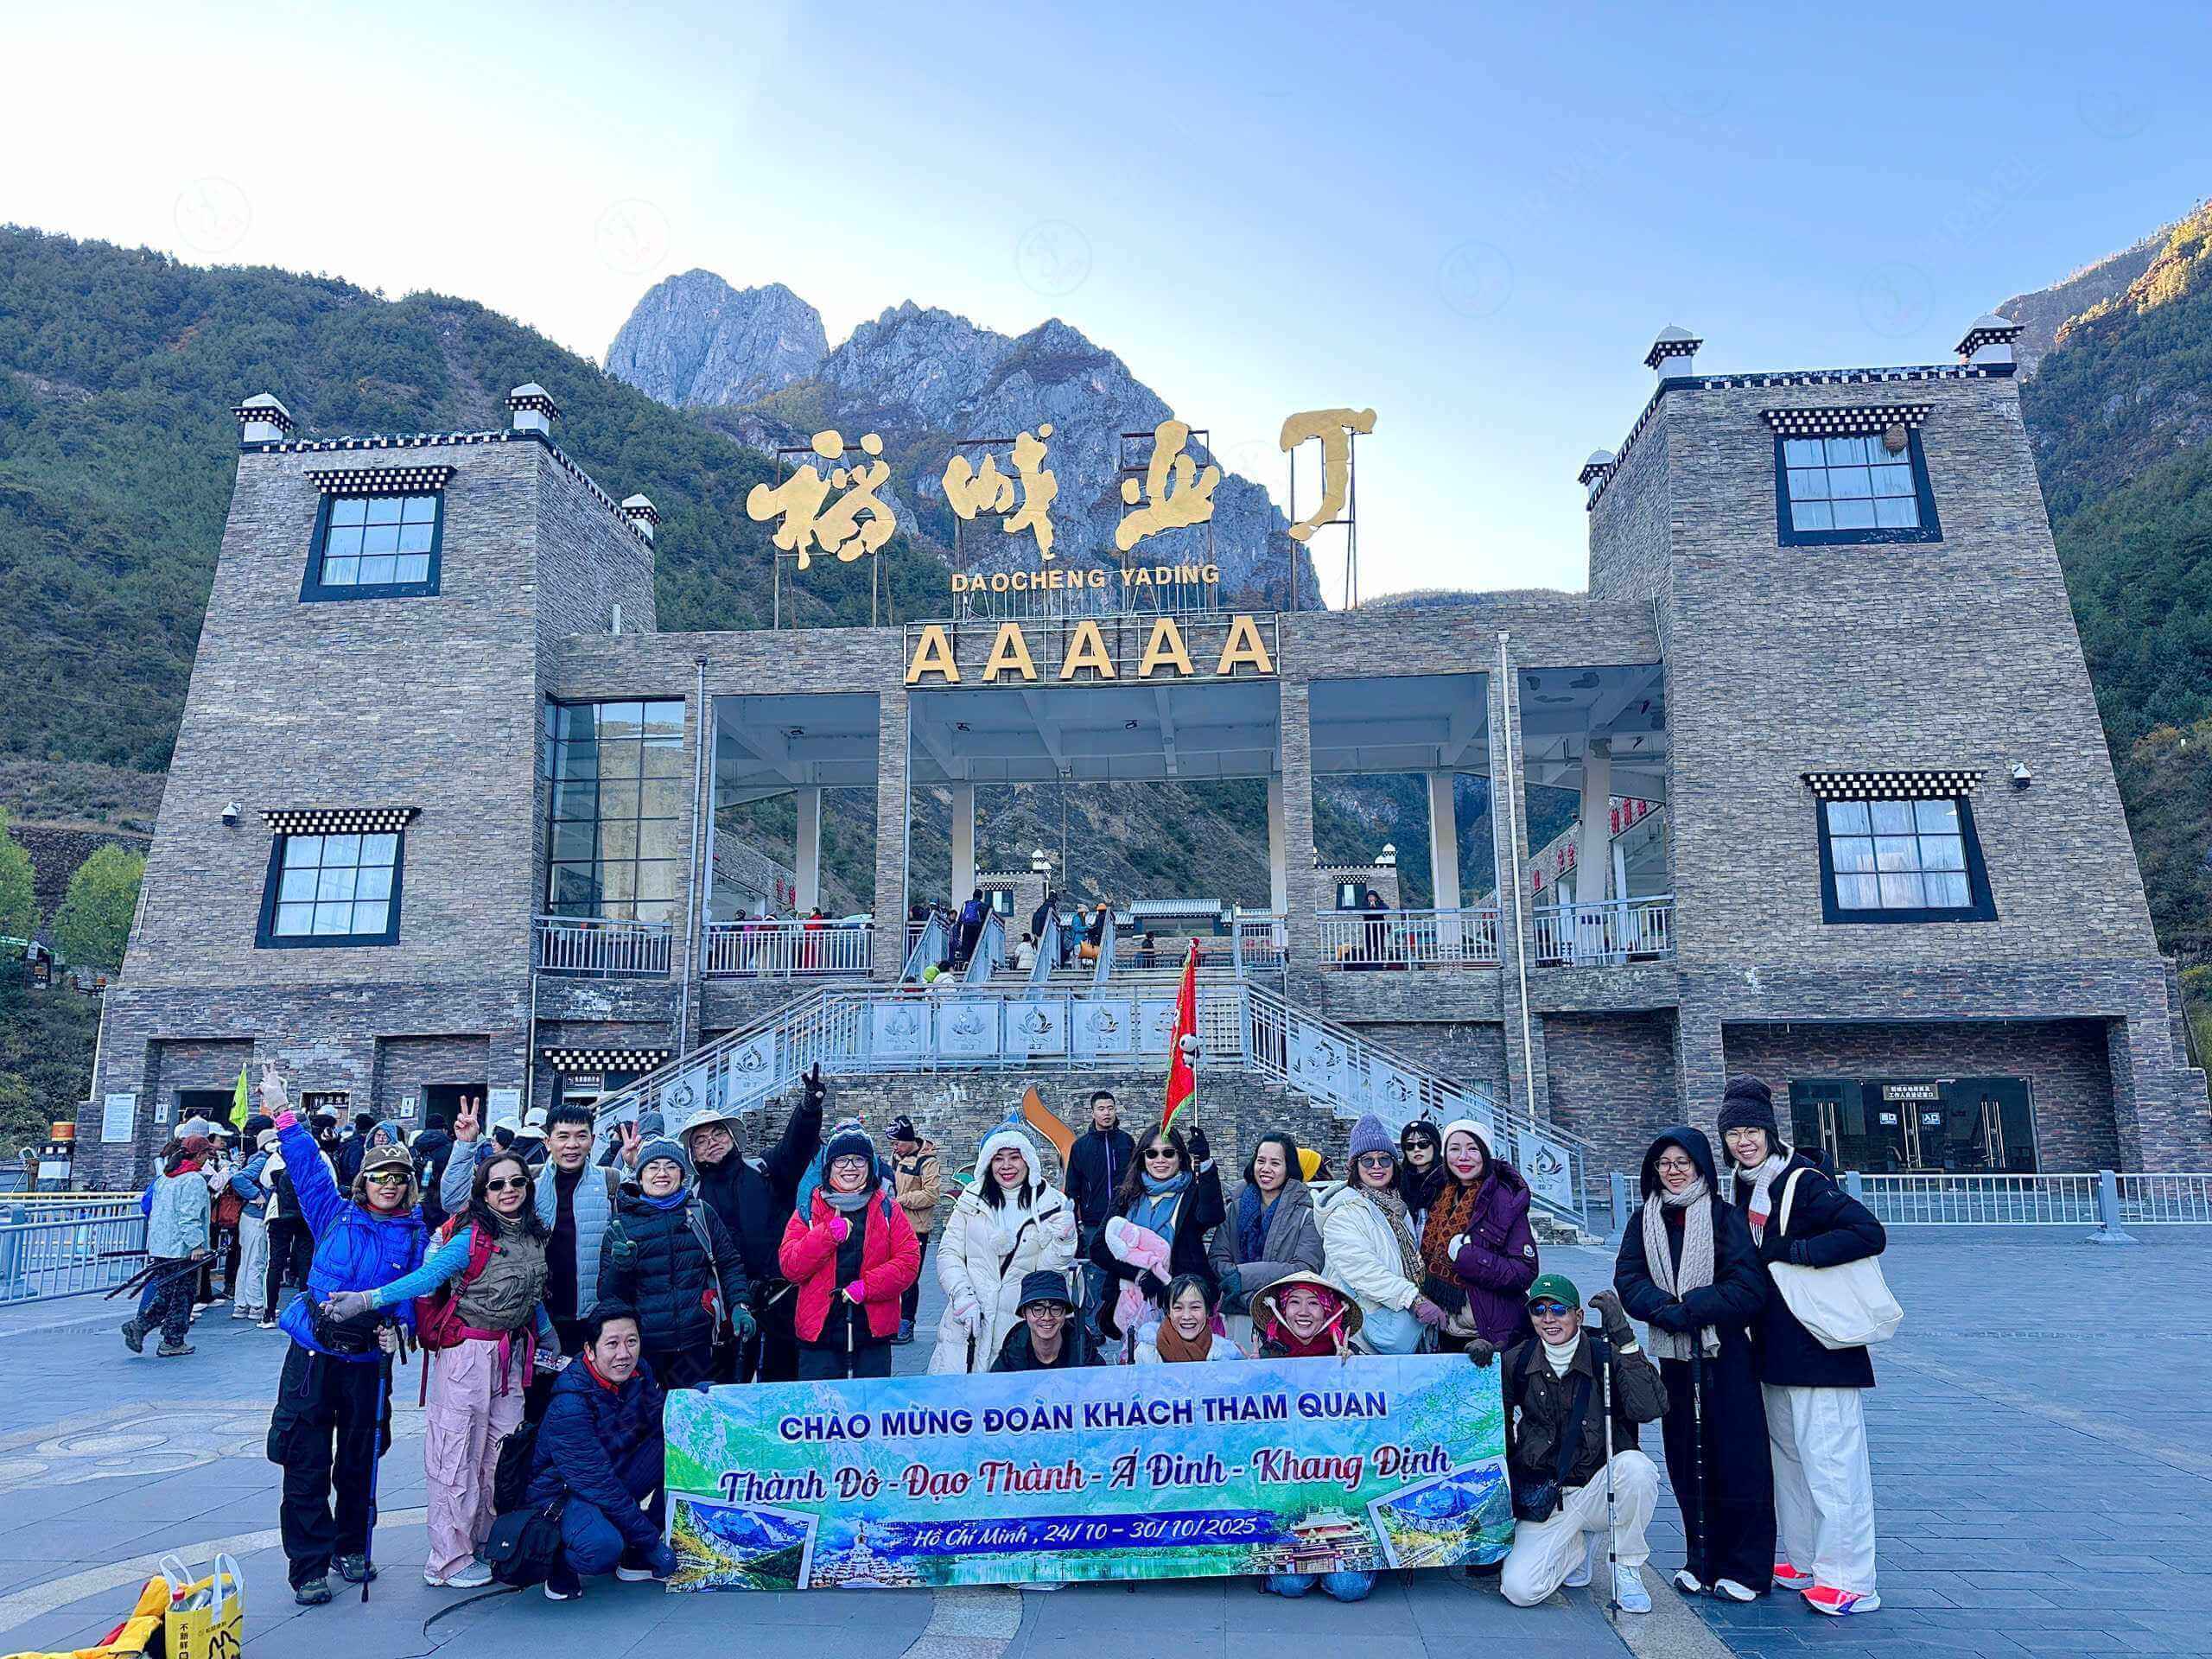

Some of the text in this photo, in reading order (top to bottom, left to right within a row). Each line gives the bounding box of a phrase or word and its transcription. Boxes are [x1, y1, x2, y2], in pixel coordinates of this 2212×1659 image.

[950, 564, 1220, 593] DAOCHENG YADING
[780, 1391, 1388, 1441] CHÀO MỪNG ĐOÀN KHÁCH THAM QUAN
[719, 1469, 828, 1503] Thành
[834, 1466, 881, 1498] Đô
[902, 1464, 973, 1502] Đạo
[978, 1459, 1088, 1493] Thành
[1109, 1447, 1141, 1488] Á
[1146, 1453, 1227, 1487] Đinh
[1253, 1448, 1363, 1490] Khang
[1373, 1445, 1453, 1481] Định
[912, 1528, 944, 1548] Hồ
[945, 1529, 976, 1547] Chí
[977, 1525, 1028, 1545] Minh
